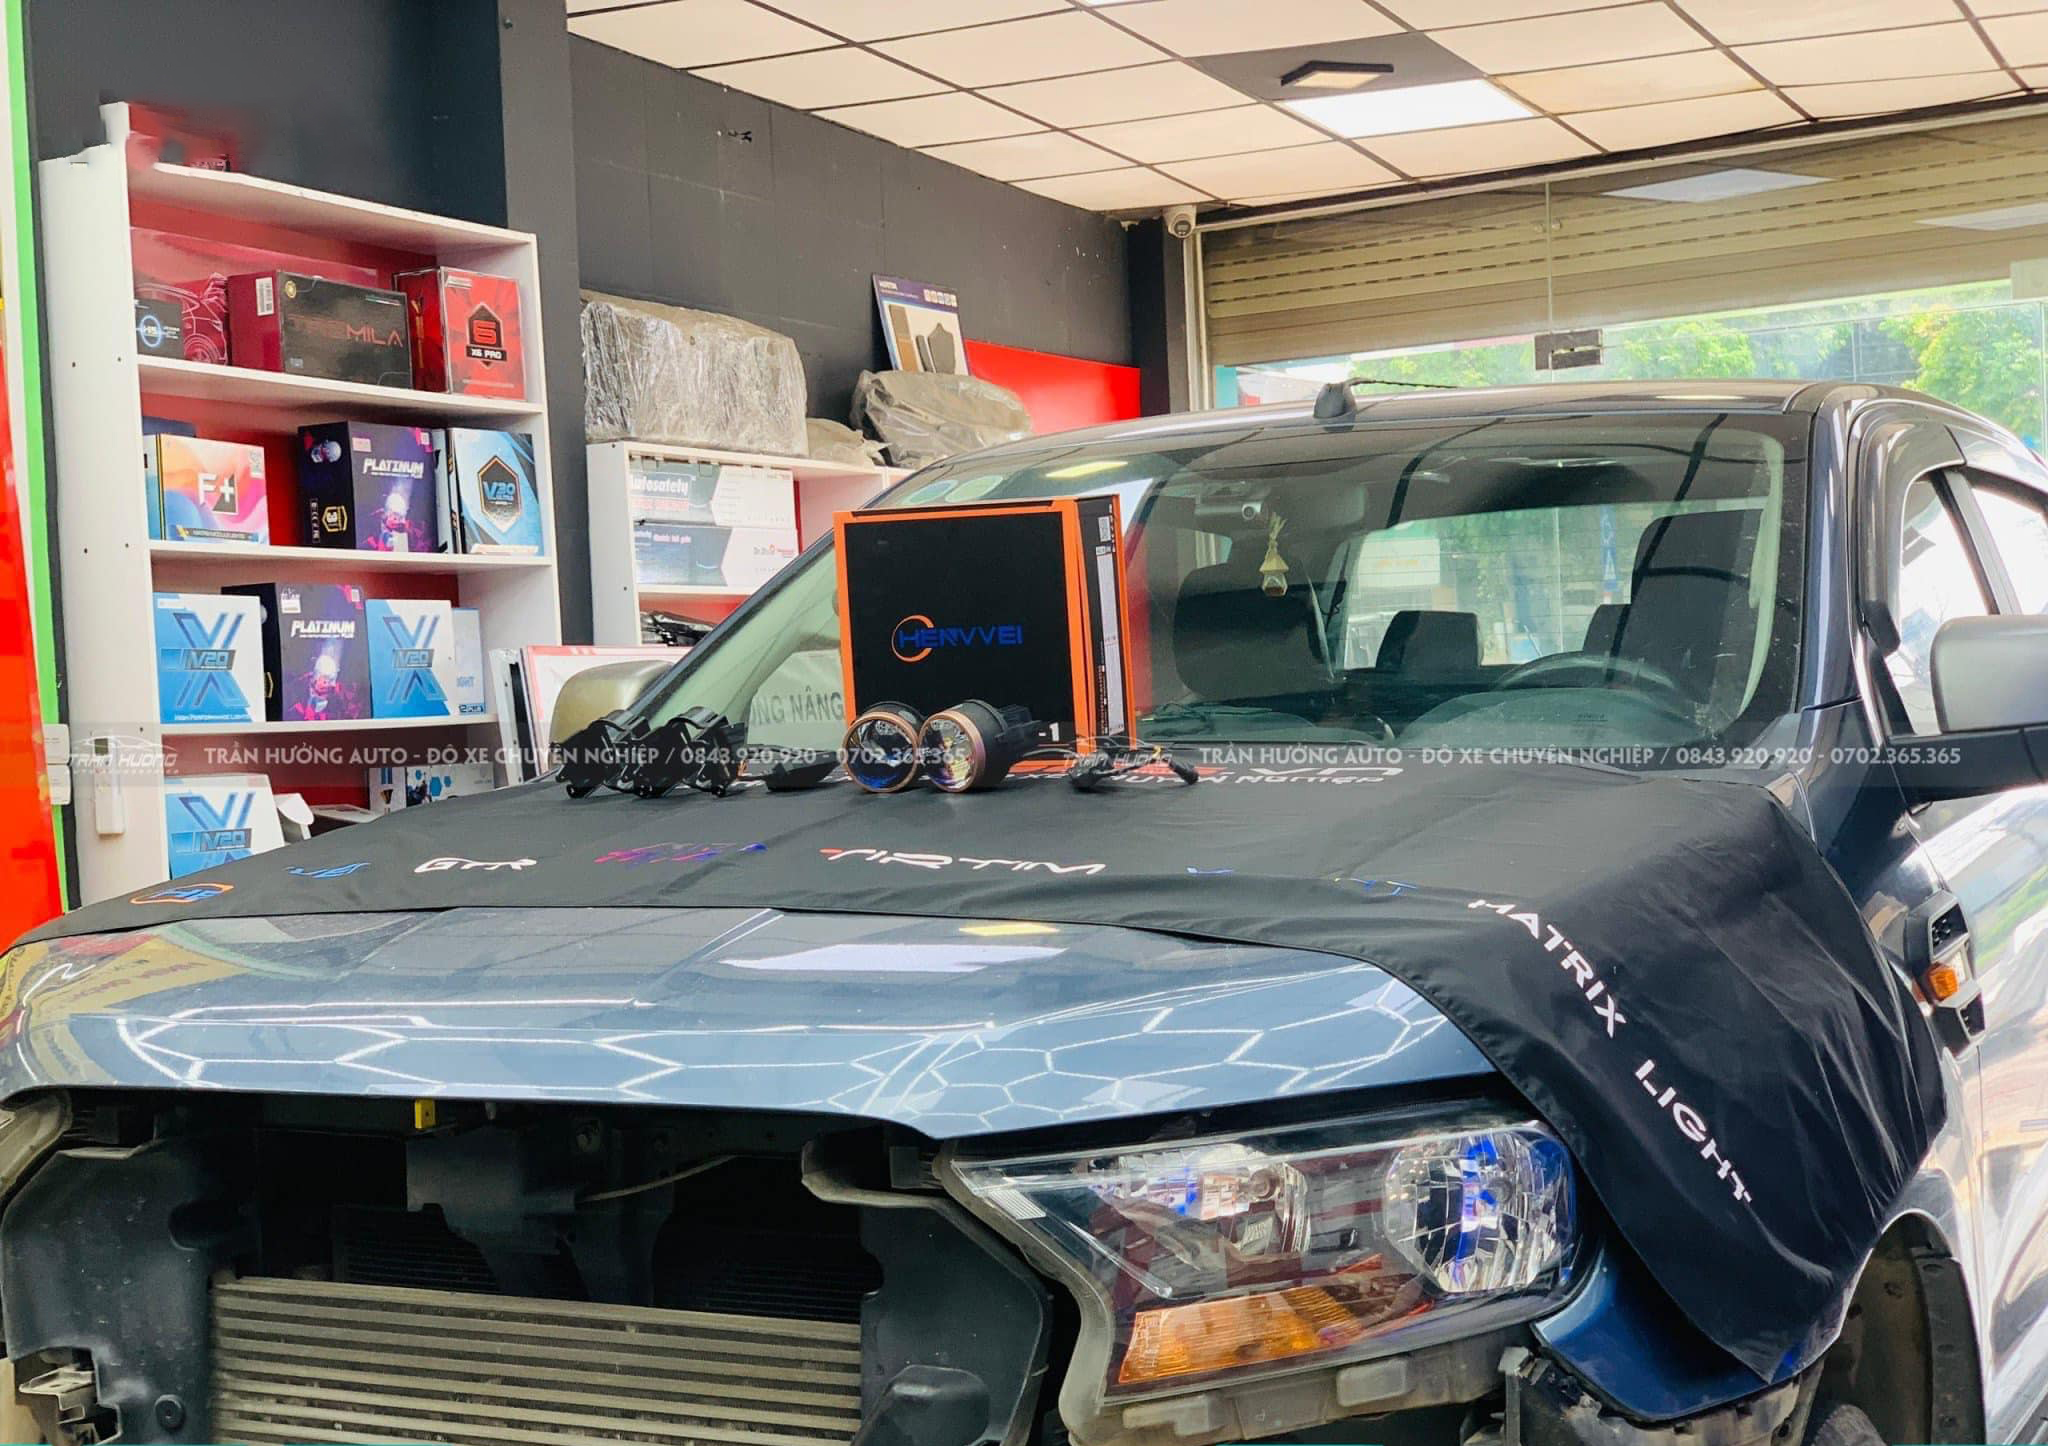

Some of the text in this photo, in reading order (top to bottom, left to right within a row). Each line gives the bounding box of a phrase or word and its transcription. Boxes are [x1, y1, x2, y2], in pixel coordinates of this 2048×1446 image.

[362, 458, 425, 478] PLATINUM
[290, 620, 355, 637] PLATINUM
[1467, 898, 1752, 1202] MATRIX LIGHT
